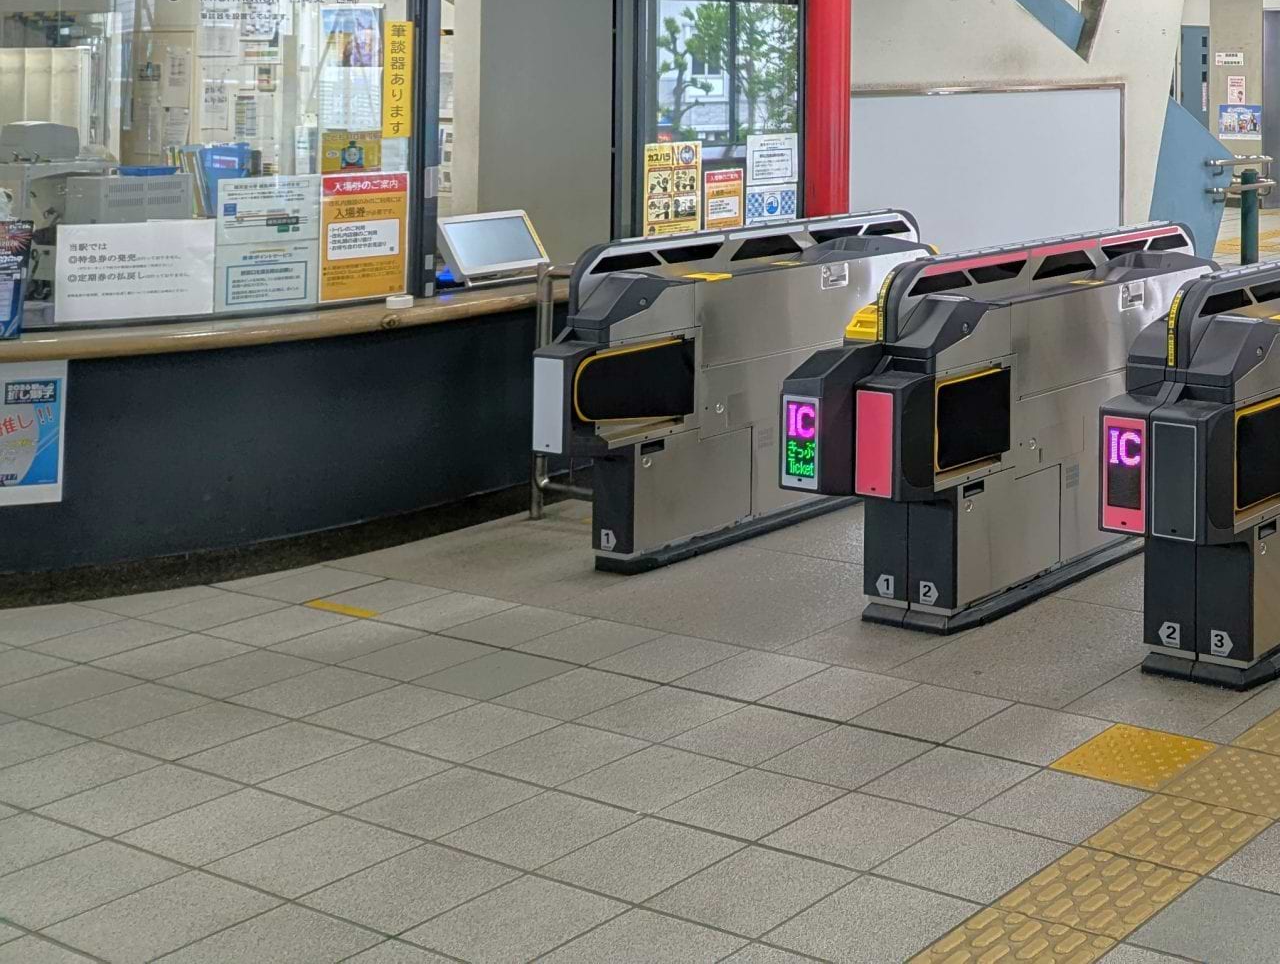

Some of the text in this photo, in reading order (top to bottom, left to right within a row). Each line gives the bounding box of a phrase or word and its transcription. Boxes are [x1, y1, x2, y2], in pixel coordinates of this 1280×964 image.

[391, 24, 407, 135] 筆談器あります
[648, 152, 671, 161] カスハラ
[333, 180, 399, 192] 入場券のご案内
[69, 243, 107, 251] 当駅では
[788, 404, 815, 437] IC
[788, 440, 816, 459] きっぷ
[1109, 429, 1142, 466] IC
[788, 458, 814, 476] Ticket
[604, 532, 610, 544] 1
[883, 578, 890, 591] 1
[923, 584, 932, 598] 2
[1166, 625, 1176, 640] 2
[1214, 633, 1224, 648] 3
